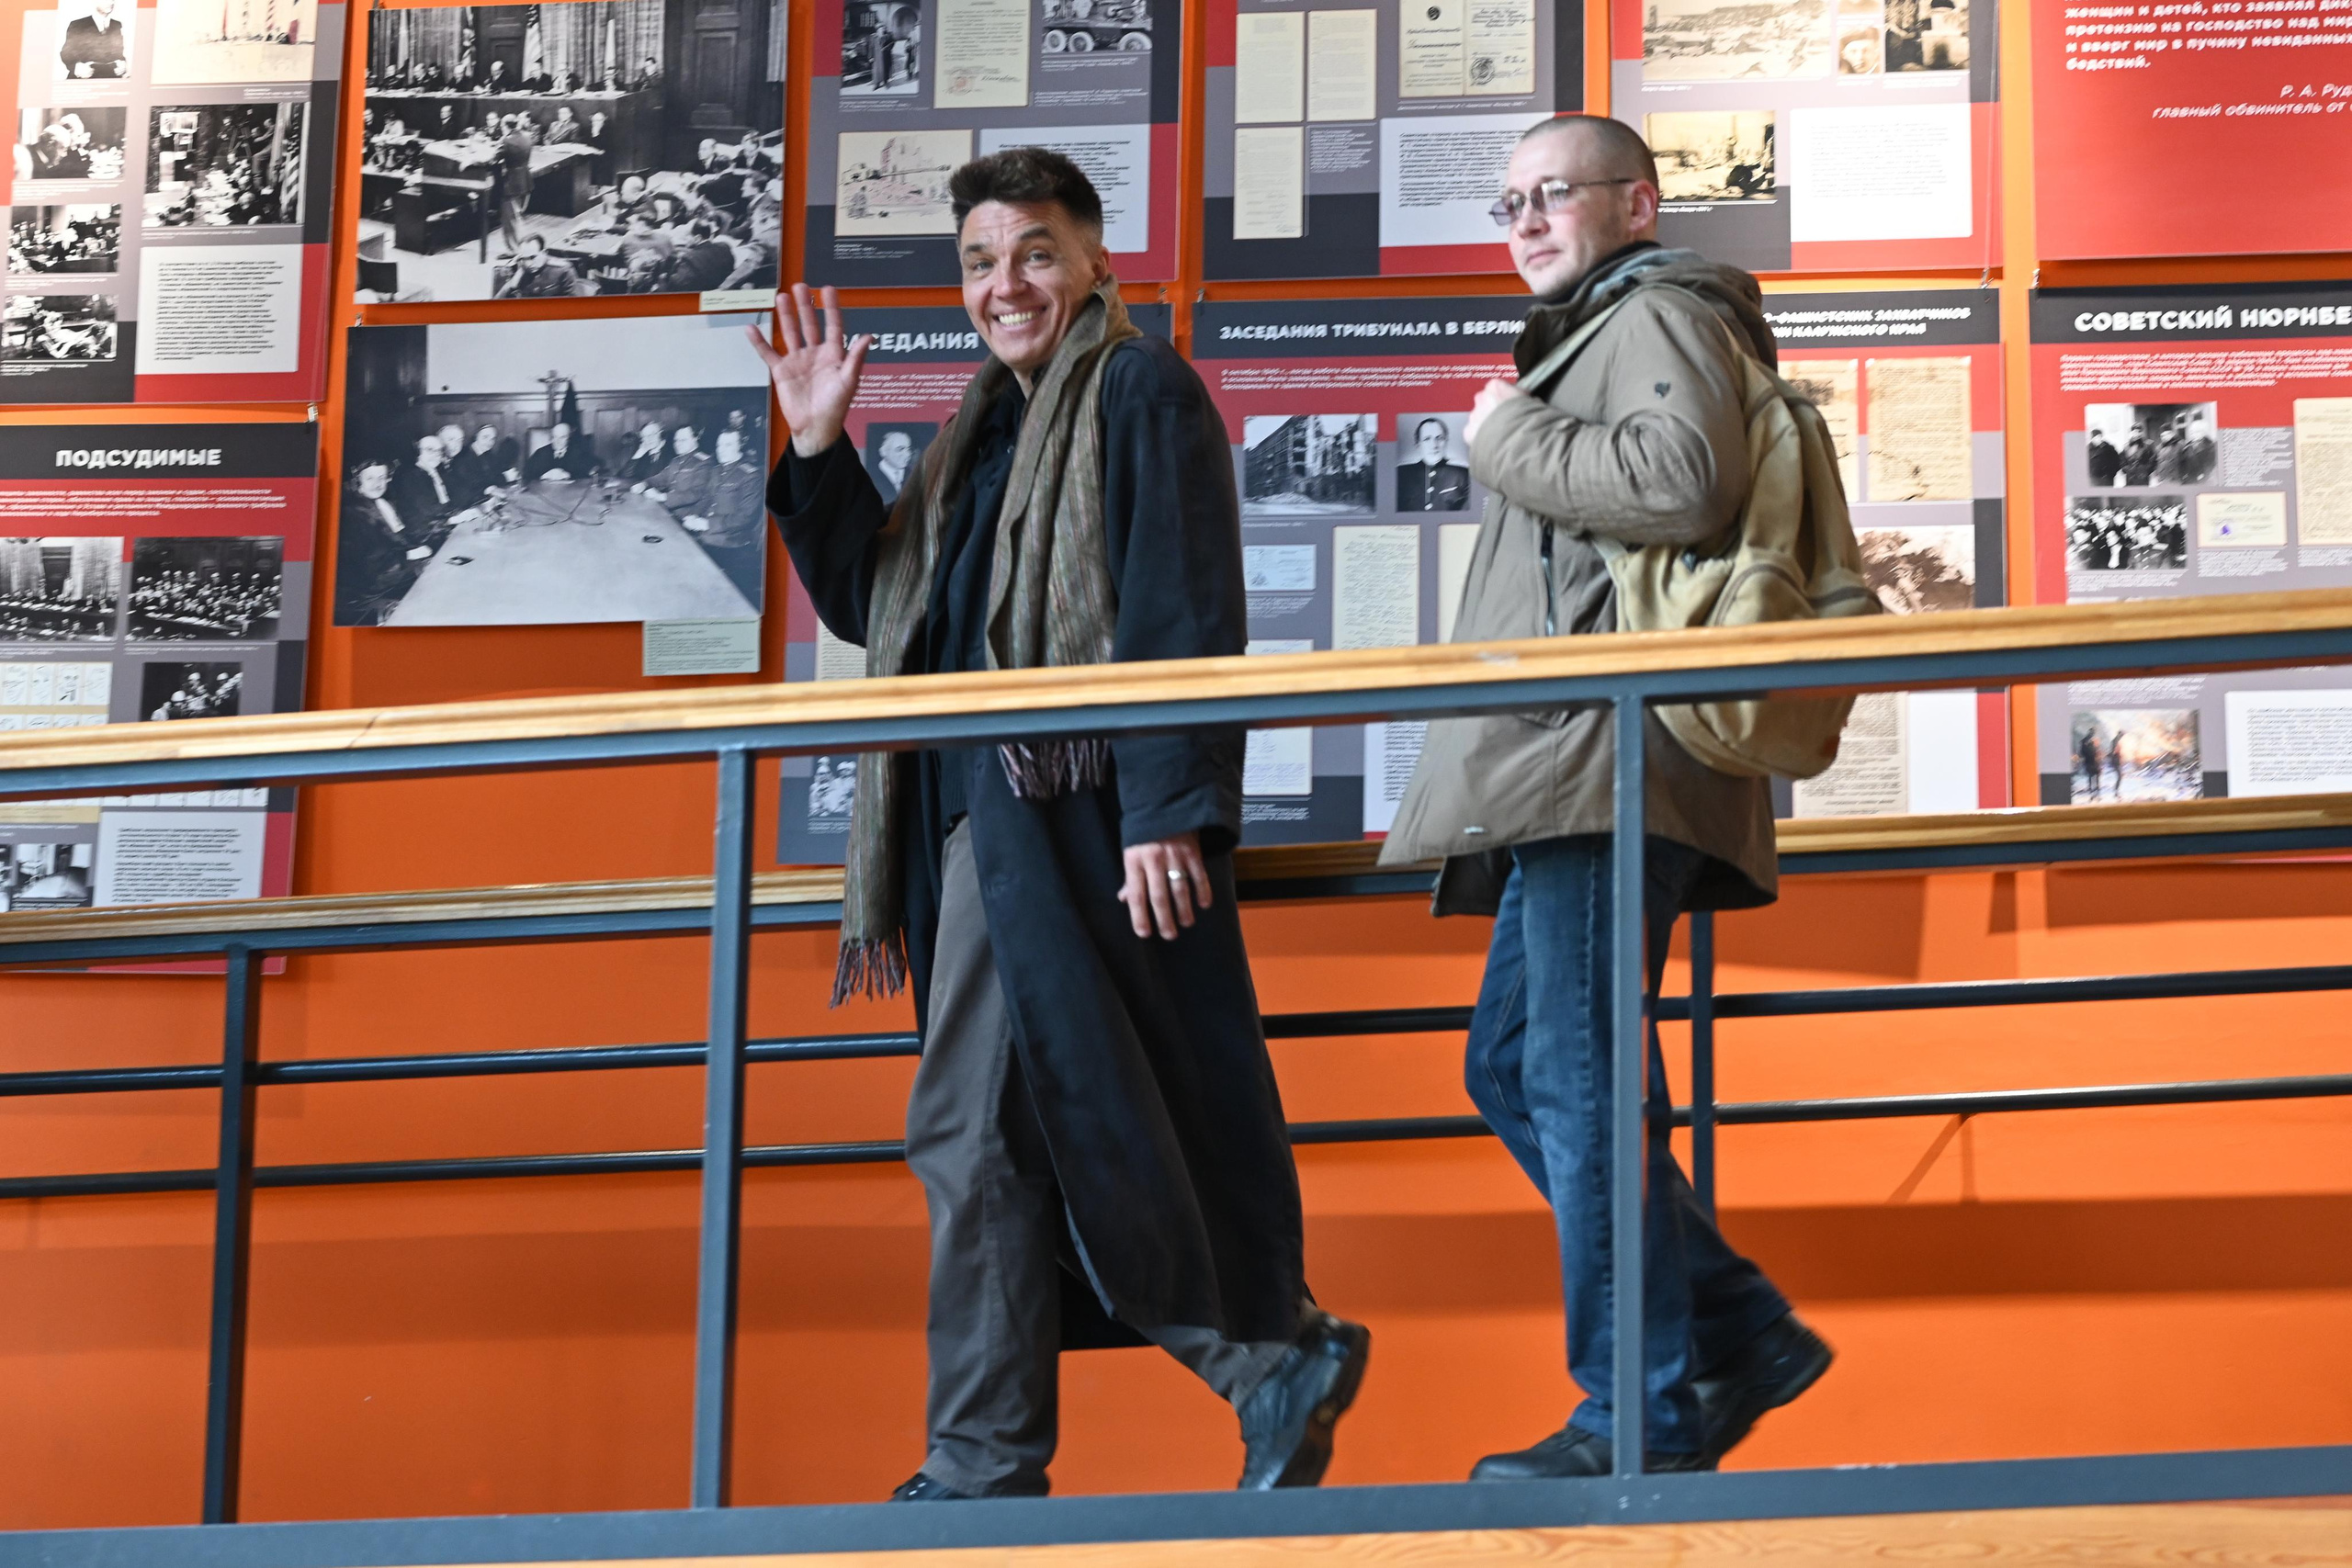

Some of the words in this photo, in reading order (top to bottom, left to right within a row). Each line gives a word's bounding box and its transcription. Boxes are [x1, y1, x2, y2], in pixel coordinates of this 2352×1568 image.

[2138, 6, 2150, 17] и
[2153, 1, 2209, 17] детей,
[2212, 2, 2243, 14] кто
[2319, 0, 2352, 12] дик
[2065, 22, 2158, 38] претензию
[2161, 21, 2182, 33] на
[2186, 17, 2285, 33] господство
[2288, 17, 2321, 28] над
[2065, 42, 2078, 53] и
[2081, 40, 2131, 54] вверг
[2134, 39, 2168, 52] мир
[2172, 39, 2183, 50] в
[2187, 37, 2247, 51] пучину
[2065, 55, 2152, 72] бедствий.
[2279, 85, 2295, 98] Р.
[2299, 84, 2317, 98] А.
[2152, 102, 2222, 118] главный
[2224, 102, 2323, 117] обвинитель
[2326, 101, 2347, 114] от
[2074, 304, 2233, 333] СОВЕТСКИЙ
[2240, 305, 2352, 328] НЮРНБЕ
[1219, 323, 1328, 342] ЗАСЕДАНИЯ
[1331, 321, 1441, 338] ТРИБУНАЛА
[1445, 321, 1460, 336] В
[55, 448, 222, 469] ПОДСУДИМЫЕ
